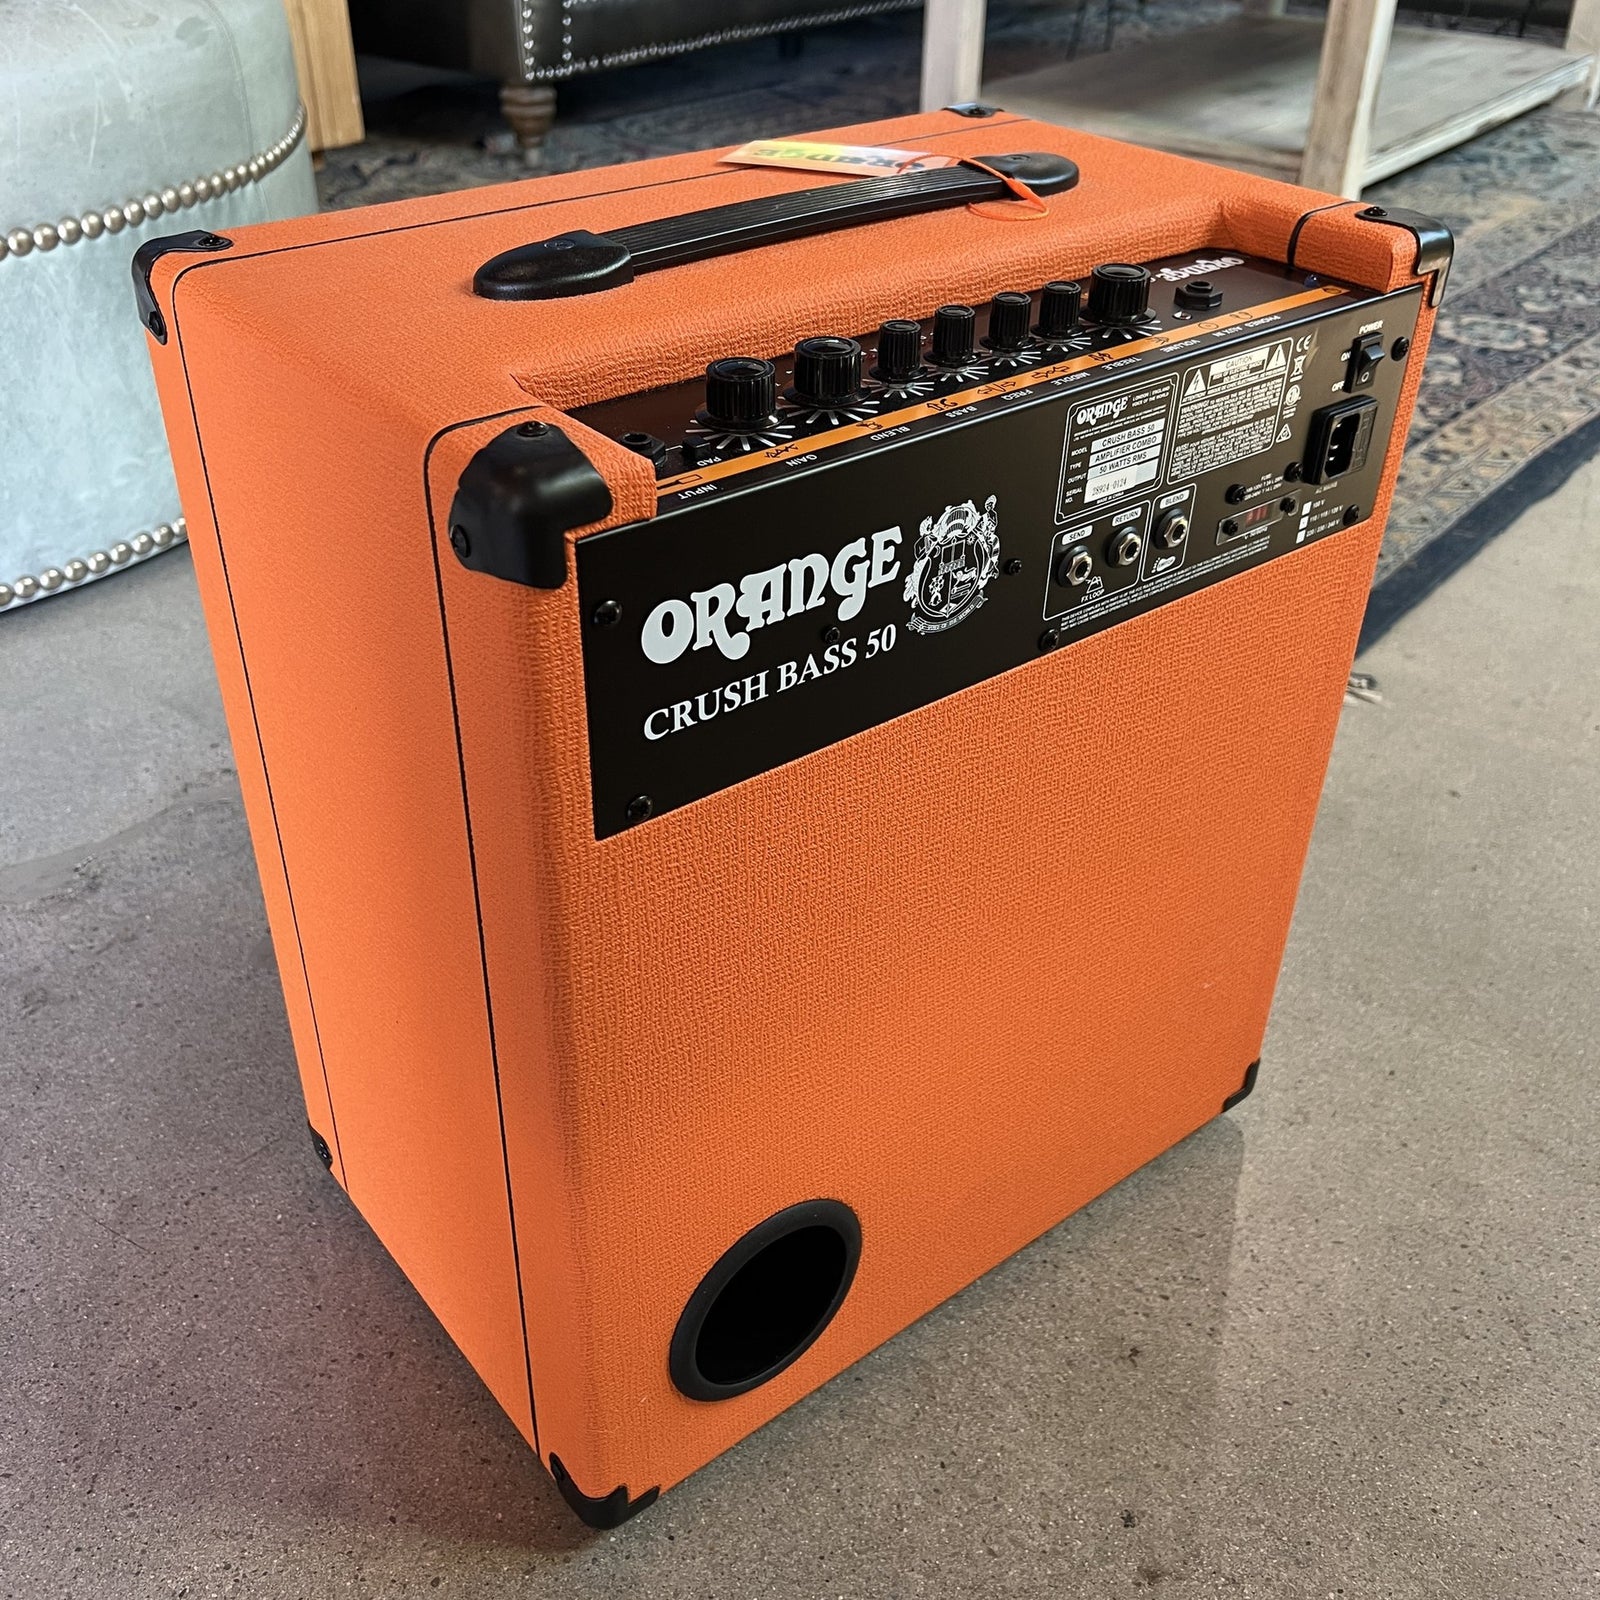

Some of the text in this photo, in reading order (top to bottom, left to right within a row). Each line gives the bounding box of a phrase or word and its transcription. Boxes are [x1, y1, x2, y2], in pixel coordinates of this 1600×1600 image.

[1245, 315, 1281, 328] PHONES
[1358, 320, 1384, 334] POWER
[1211, 330, 1225, 338] IN
[1160, 339, 1201, 353] VOLUME
[1101, 356, 1143, 371] TREBLE
[1225, 355, 1252, 369] CAUTION
[1050, 371, 1091, 386] MIDDLE
[1001, 389, 1034, 401] FREQ
[945, 405, 978, 418] BASS
[1076, 396, 1128, 425] ORANGE
[870, 425, 911, 442] BLEND
[1102, 423, 1155, 448] CRUSH BASS 50
[1071, 446, 1088, 456] MODEL
[1095, 435, 1157, 463] AMPLIFIER COMBO
[696, 456, 723, 467] PAD
[785, 454, 818, 467] GAIN
[1069, 461, 1082, 470] TYPE
[1099, 451, 1147, 474] 50 WATTS RMS
[1067, 472, 1087, 484] OUTPUT
[678, 483, 718, 500] INPUT
[1065, 487, 1083, 497] SERIAL
[1165, 493, 1184, 506] BLEND
[1115, 511, 1139, 524] RETURN
[1069, 529, 1085, 541] SEND
[641, 525, 903, 664] ORANGE
[1081, 588, 1105, 603] FX LOOP
[643, 624, 897, 740] CRUSH BASS 50
